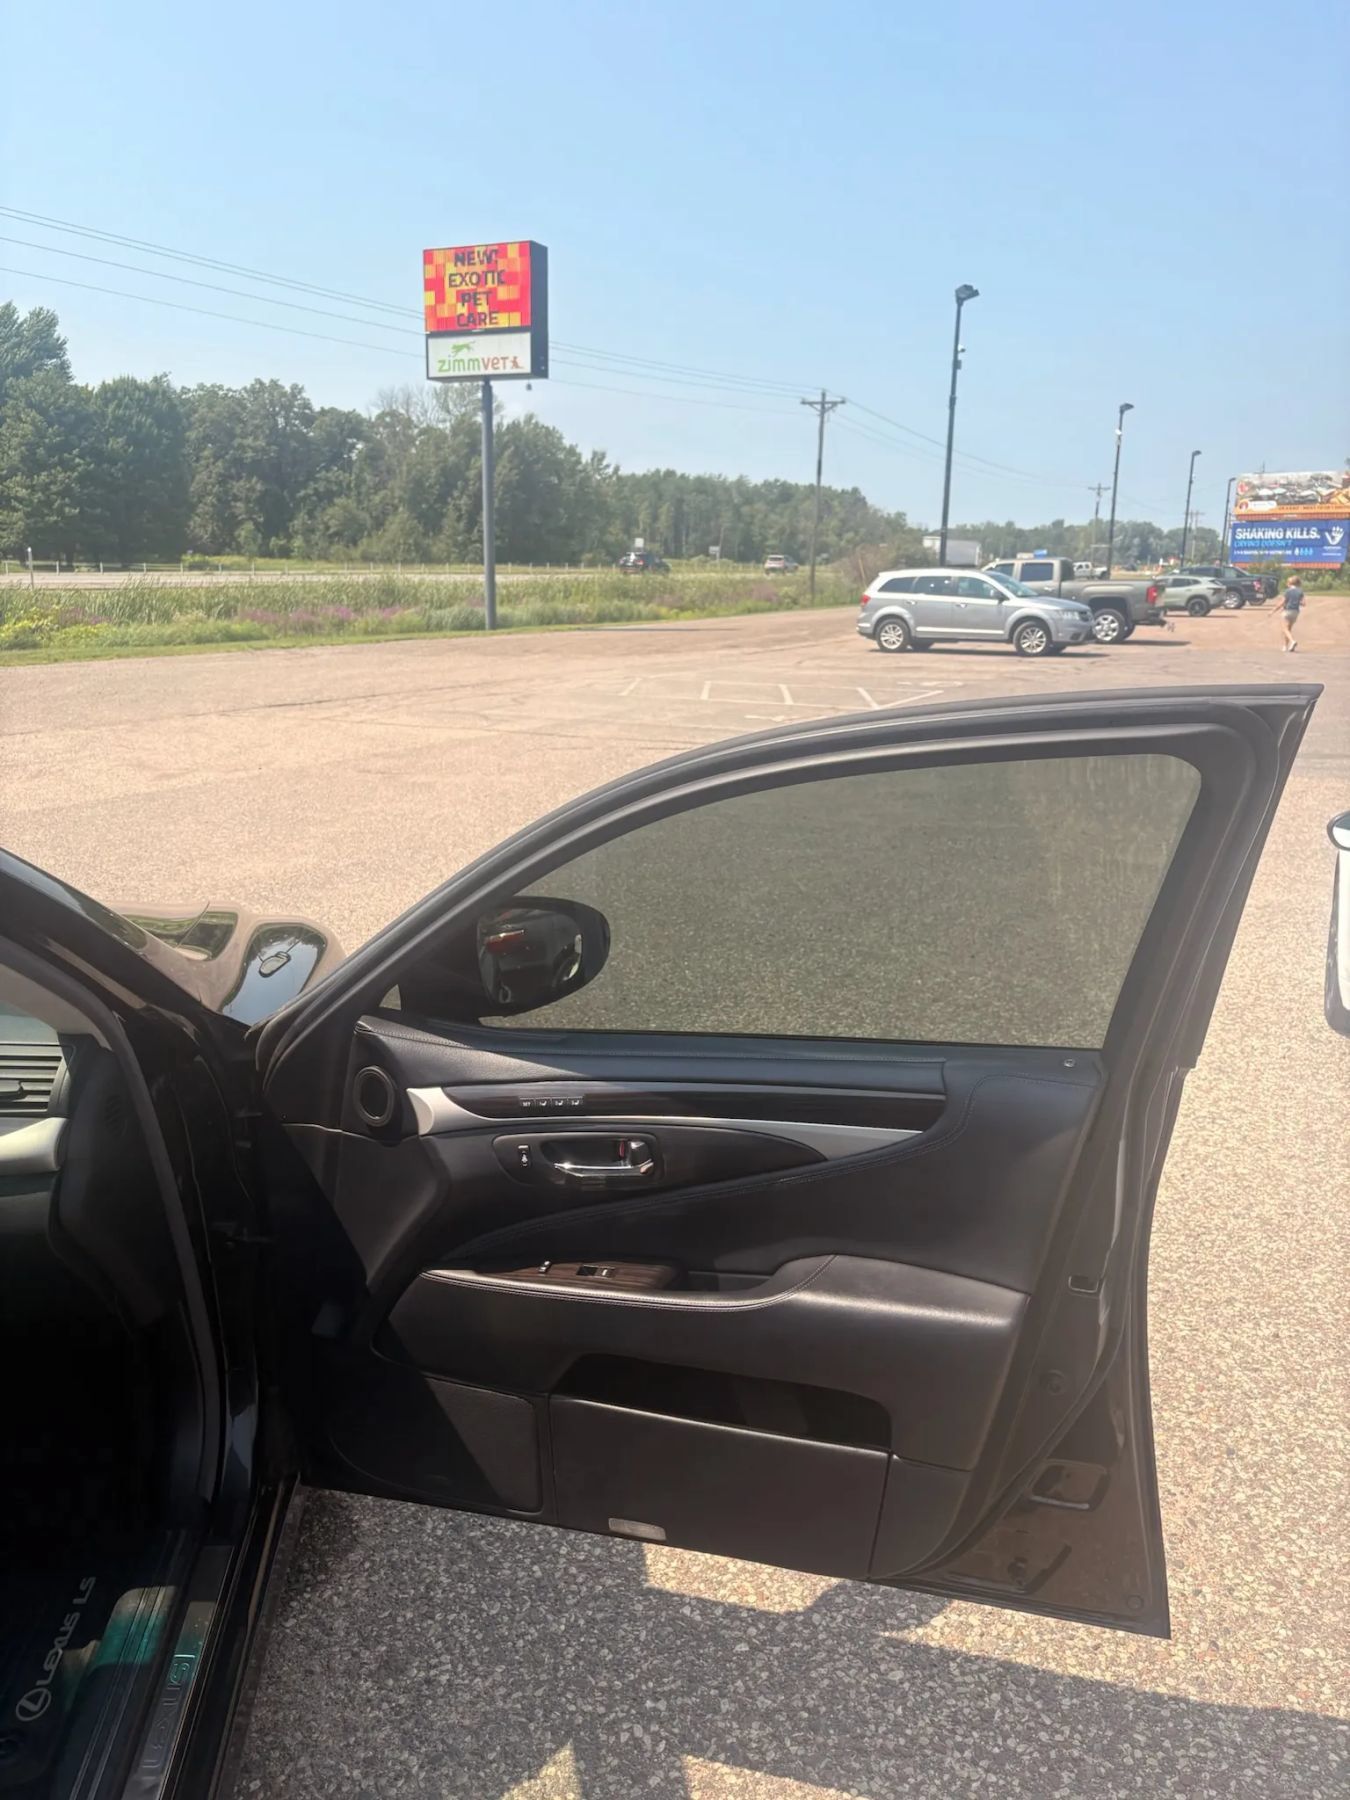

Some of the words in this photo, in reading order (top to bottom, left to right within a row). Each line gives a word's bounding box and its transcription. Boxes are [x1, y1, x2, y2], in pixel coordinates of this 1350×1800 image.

[448, 269, 505, 288] EXOTIC
[461, 290, 493, 307] PET
[456, 311, 499, 328] CARE
[1235, 528, 1284, 540] SHAKING
[1286, 527, 1321, 540] KILLS.
[35, 1612, 81, 1686] LEXUS
[72, 1576, 96, 1605] LS
